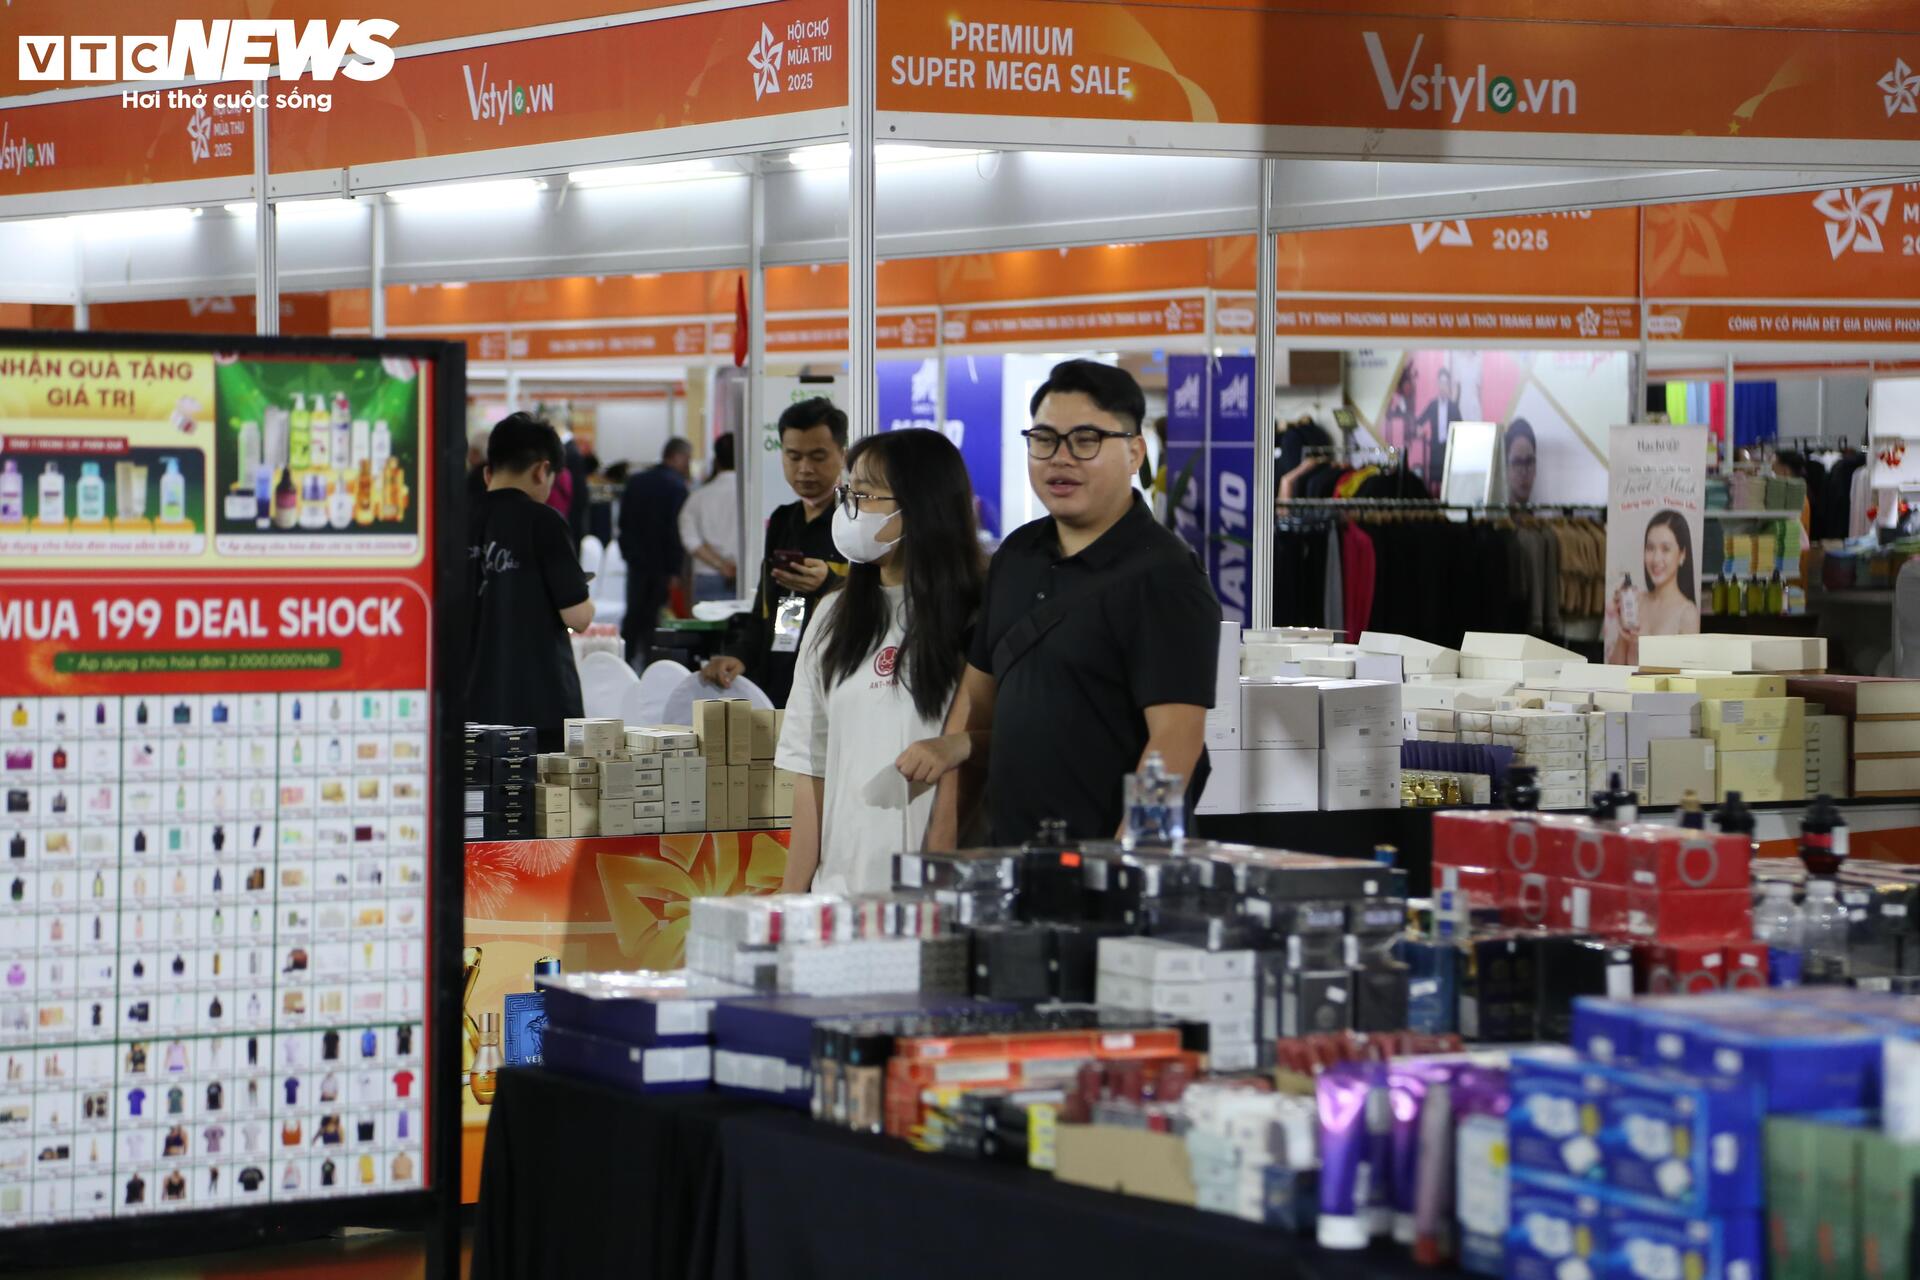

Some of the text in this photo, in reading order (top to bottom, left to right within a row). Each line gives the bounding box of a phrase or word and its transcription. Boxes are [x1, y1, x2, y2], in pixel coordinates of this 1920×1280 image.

[788, 17, 829, 43] HỘI CHỢ
[951, 22, 1074, 56] PREMIUM
[788, 45, 832, 66] MÙA THU
[788, 73, 813, 91] 2025
[891, 55, 1131, 96] SUPER MEGA SALE
[1363, 32, 1577, 123] Vstyle.vn
[463, 63, 554, 125] Vstyle.VN
[213, 142, 233, 158] 2025
[1492, 228, 1549, 251] 2025
[68, 353, 120, 379] QUÀ
[129, 353, 193, 386] TẶNG
[48, 384, 135, 414] GIÁ TRỊ
[0, 596, 404, 639] MUA 199 DEAL SHOCK
[77, 654, 100, 671] Áp
[101, 656, 138, 672] dụng
[141, 656, 167, 668] cho
